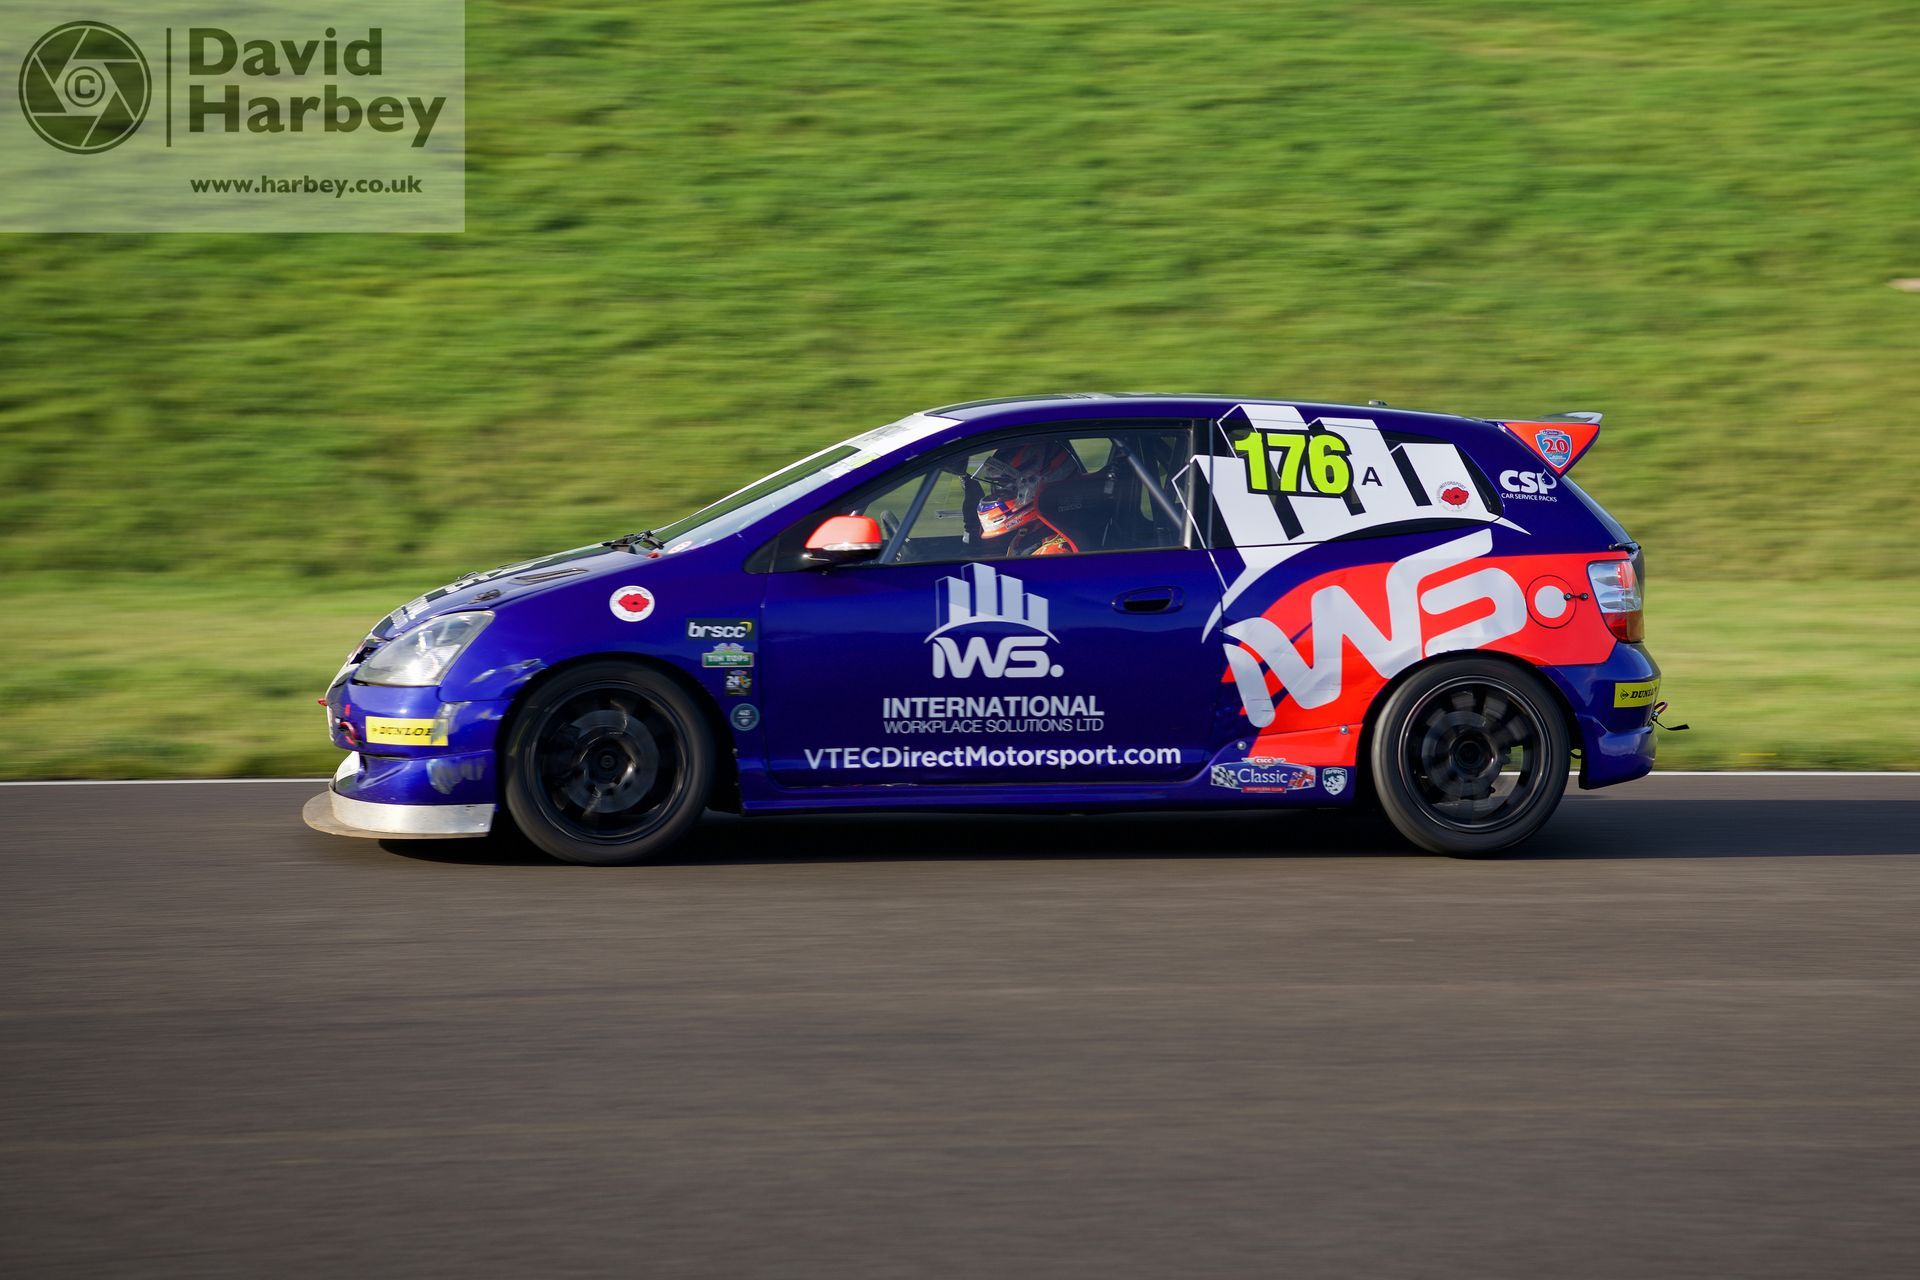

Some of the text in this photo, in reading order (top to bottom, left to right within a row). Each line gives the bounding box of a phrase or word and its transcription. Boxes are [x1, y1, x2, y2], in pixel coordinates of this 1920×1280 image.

[1542, 438, 1569, 454] 20
[1235, 432, 1383, 494] 176 A
[1499, 469, 1557, 494] CSP
[1515, 493, 1538, 501] SERVICE
[1538, 494, 1558, 502] PACKS
[687, 621, 747, 638] brscc
[1629, 686, 1658, 699] DUNL
[882, 695, 1105, 719] INTERNATIONAL
[884, 718, 1104, 734] WORKPLACE SOLUTIONS LTD
[804, 745, 1182, 770] VTECDirectMotorsport.com
[1237, 768, 1288, 784] Classic
